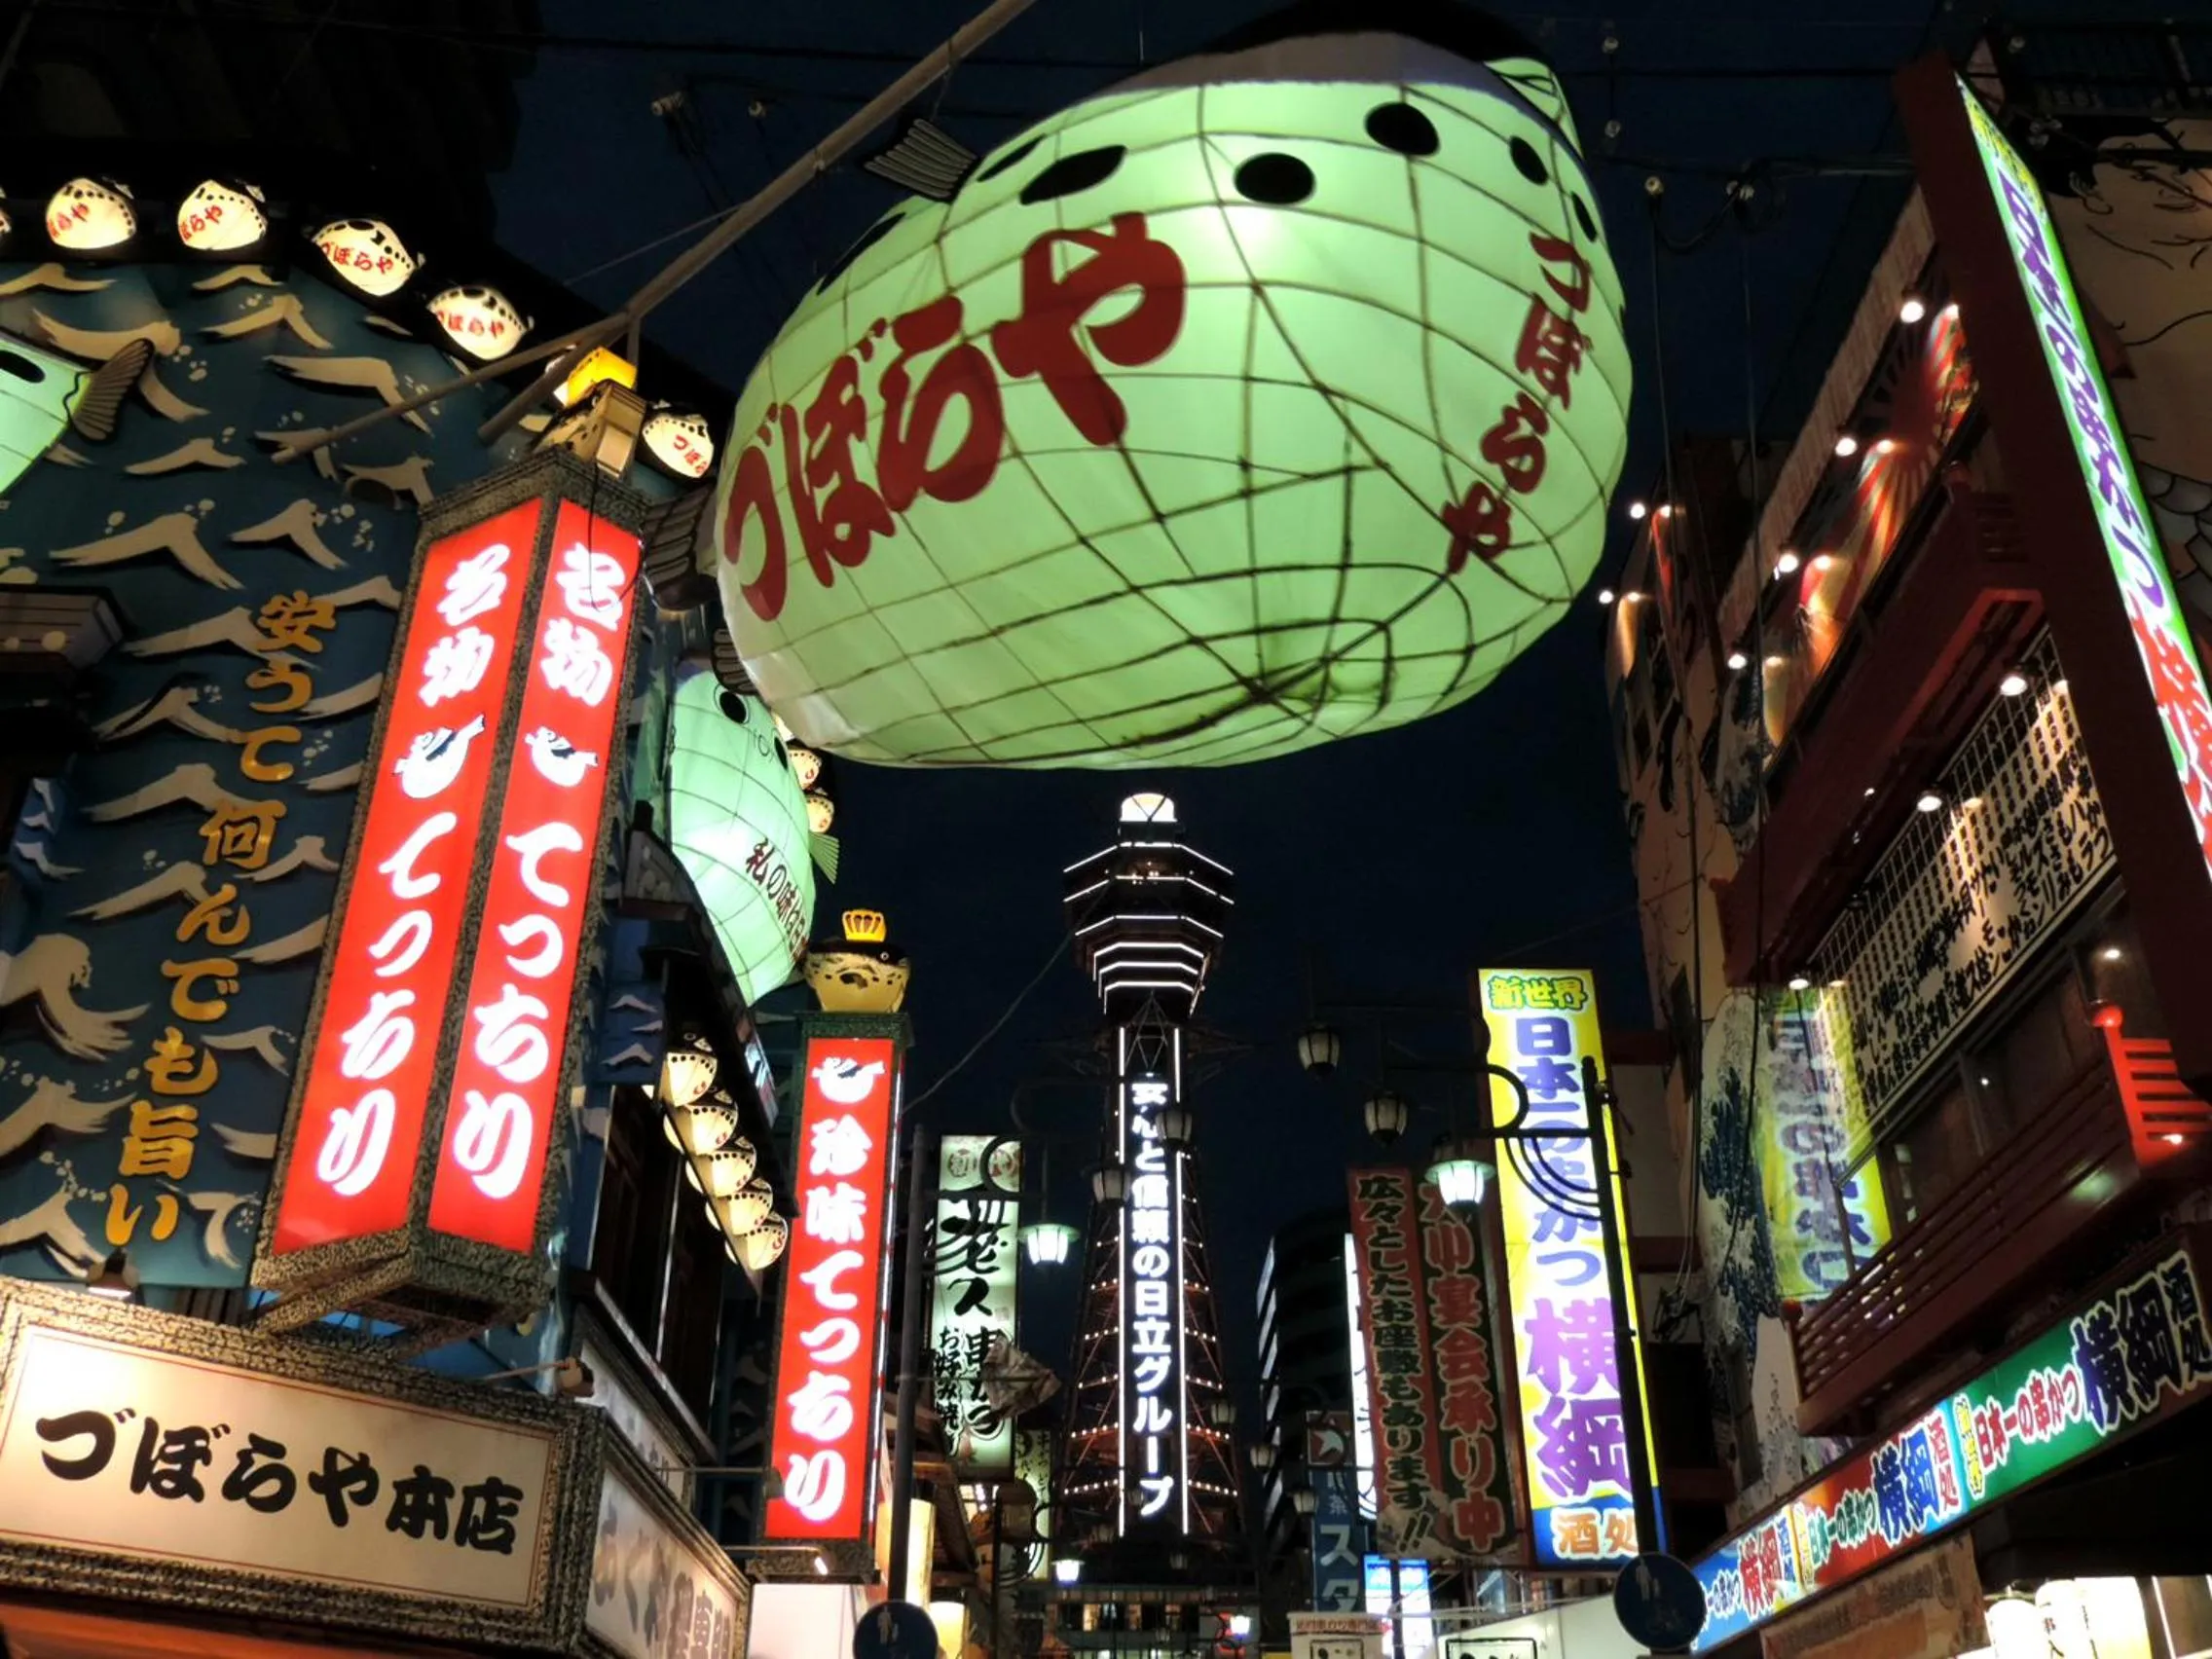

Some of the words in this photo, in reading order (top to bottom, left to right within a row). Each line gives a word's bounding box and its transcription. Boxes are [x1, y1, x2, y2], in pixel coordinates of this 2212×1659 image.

[724, 210, 1187, 621] づぼらや
[417, 542, 511, 707] 名物
[539, 540, 627, 708] 名物
[315, 811, 458, 1197] てっちり
[452, 821, 584, 1199] てっちり
[1489, 977, 1587, 1011] 新世界
[783, 1119, 872, 1522] 珍味てっちり
[35, 1407, 524, 1556] づぼらや本店
